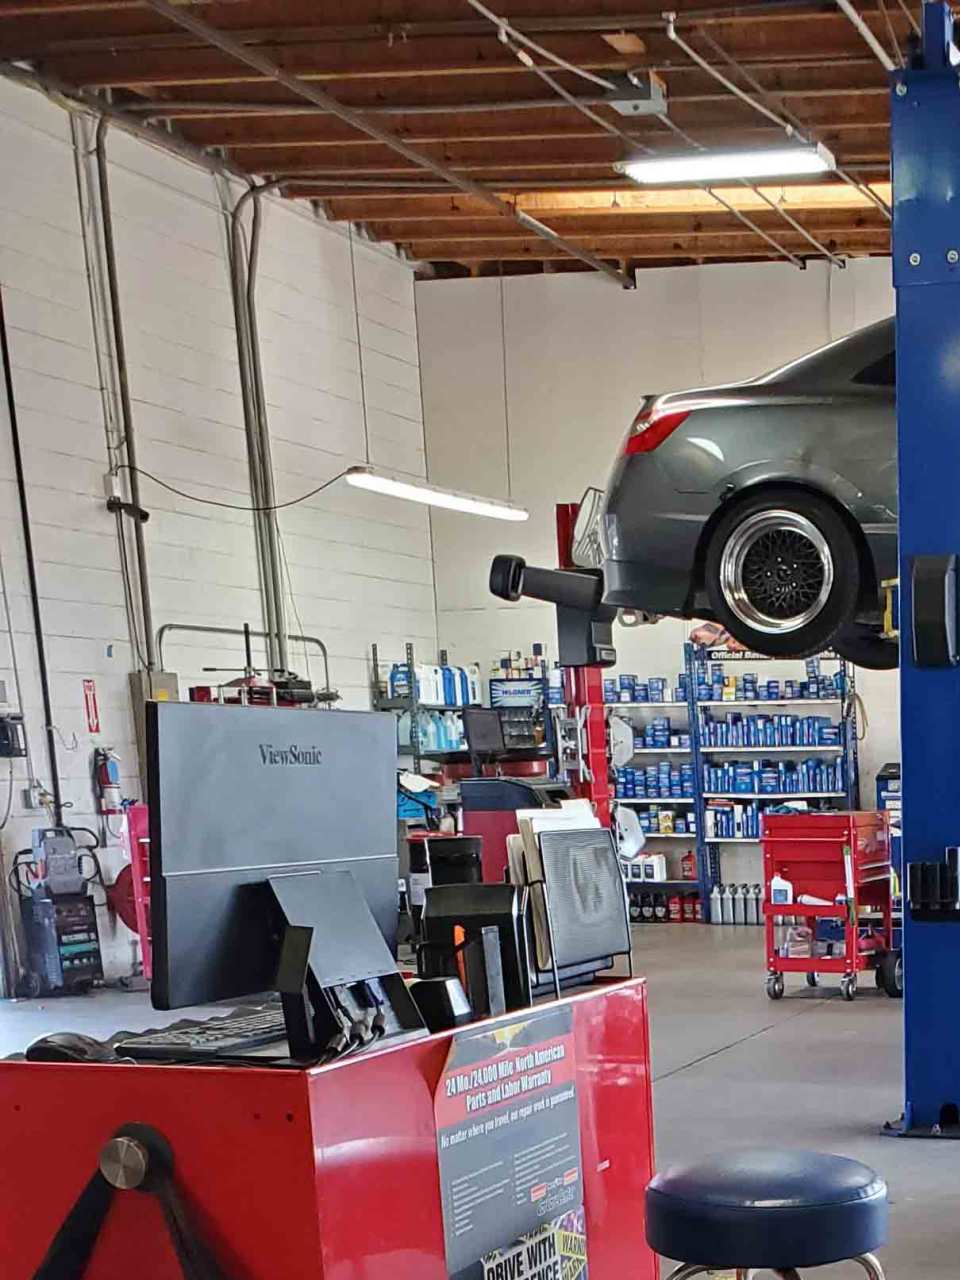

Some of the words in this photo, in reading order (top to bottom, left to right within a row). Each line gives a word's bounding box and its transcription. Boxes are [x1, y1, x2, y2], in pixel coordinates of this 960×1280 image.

[258, 743, 323, 766] ViewSonic
[446, 1079, 456, 1096] 24
[498, 1060, 514, 1078] Mile
[515, 1054, 534, 1073] North
[535, 1044, 565, 1067] American
[466, 1091, 487, 1112] Parts
[487, 1086, 501, 1104] and
[501, 1079, 521, 1100] Labor
[521, 1069, 552, 1092] Warranty
[450, 1129, 468, 1145] matter
[468, 1121, 484, 1137] where
[526, 1231, 556, 1271] WITH
